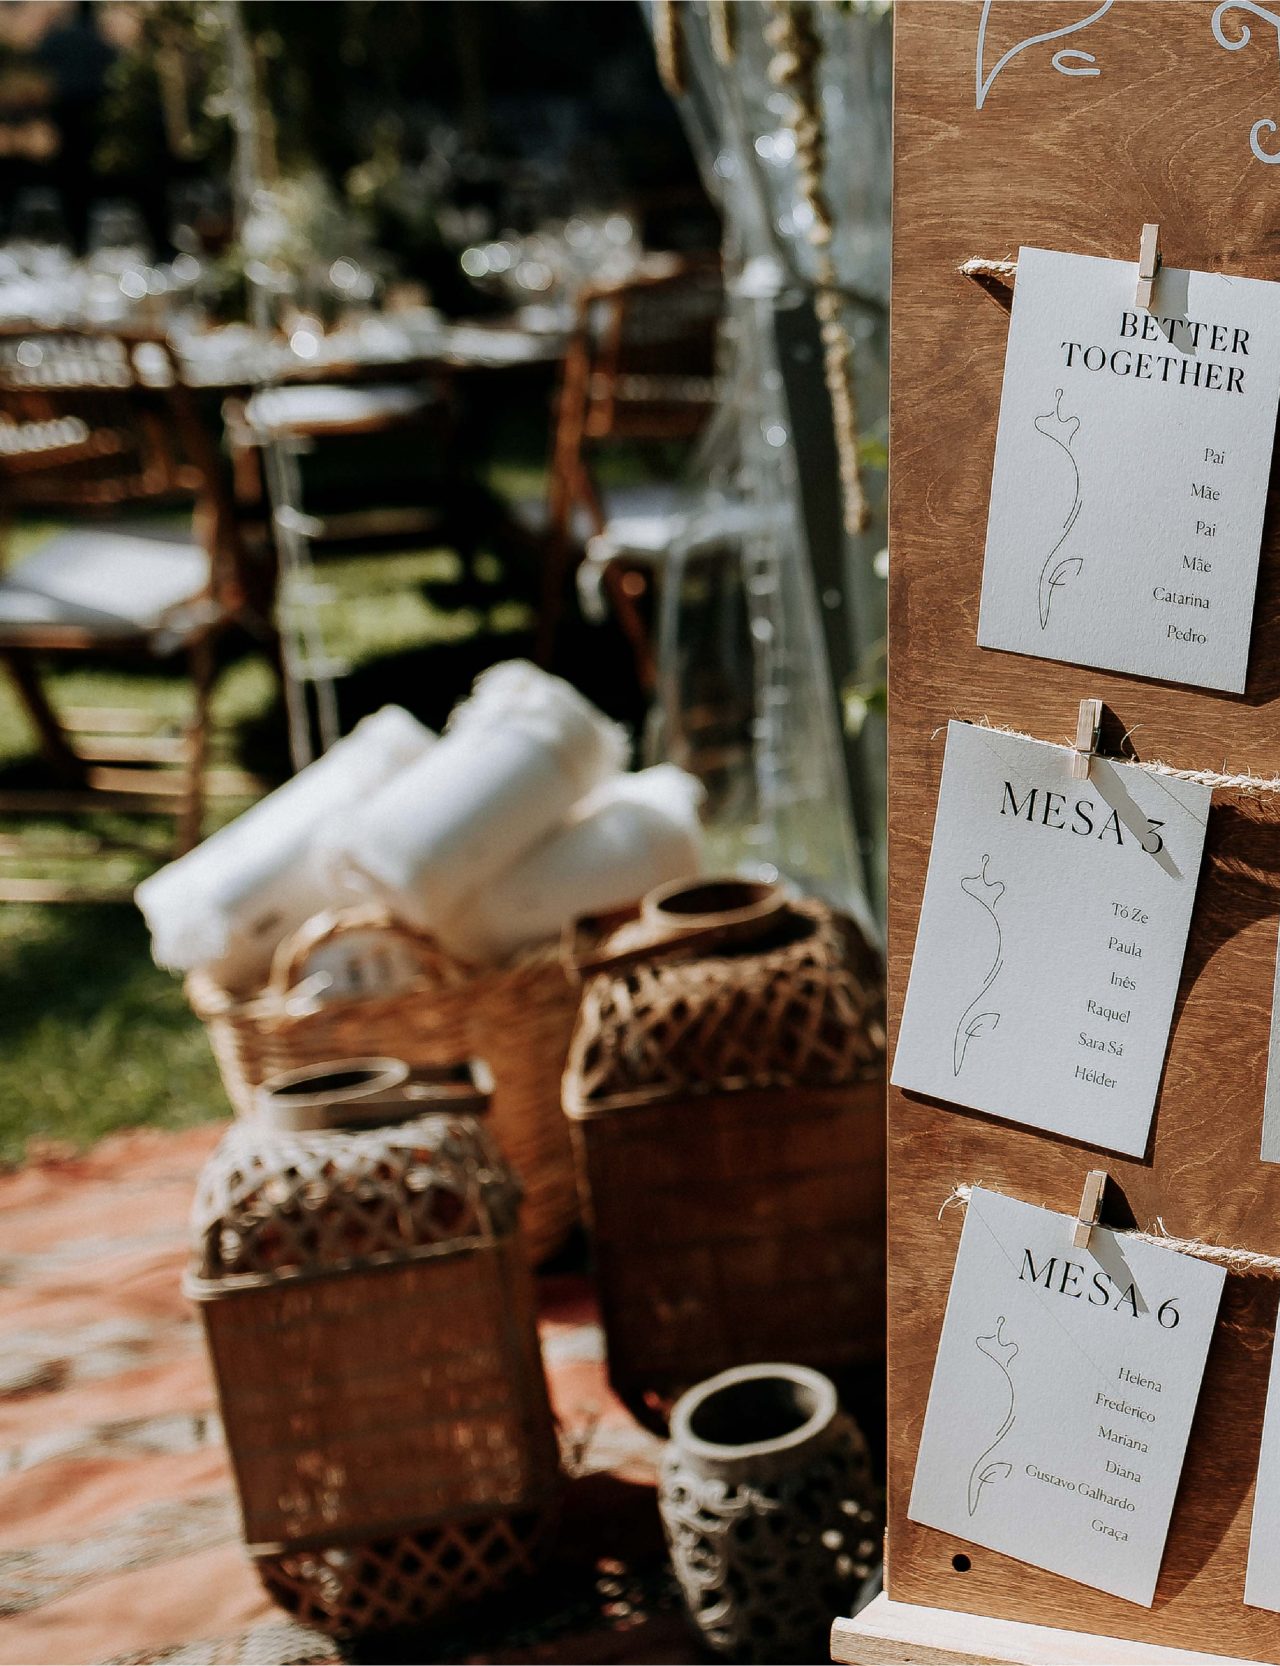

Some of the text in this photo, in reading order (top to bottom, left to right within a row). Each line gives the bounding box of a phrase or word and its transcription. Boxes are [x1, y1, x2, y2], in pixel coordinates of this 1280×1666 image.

[1120, 311, 1250, 355] BETTER
[1061, 342, 1245, 394] TOGETHER
[1204, 448, 1225, 466] Pai
[1191, 483, 1220, 501] Mãe
[1196, 521, 1216, 538] Pai
[1182, 555, 1212, 573] Mãe
[1153, 587, 1210, 609] Catarina
[1167, 625, 1206, 644] Pedro
[1000, 781, 1166, 854] MESA 3
[1112, 903, 1149, 924] Tó Ze
[1108, 937, 1142, 958] Paula
[1111, 972, 1136, 991] Inês
[1087, 999, 1131, 1024] Raquel
[1078, 1032, 1123, 1056] Sara Sá
[1075, 1065, 1117, 1089] Hélder
[1018, 1248, 1180, 1329] MESA 6
[1118, 1367, 1162, 1392] Helena
[1095, 1392, 1156, 1423] Frederico
[1098, 1425, 1148, 1454] Mariana
[1105, 1460, 1142, 1483] Diana
[1025, 1464, 1135, 1512] Gustavo Galhardo
[1091, 1519, 1128, 1542] Graça
